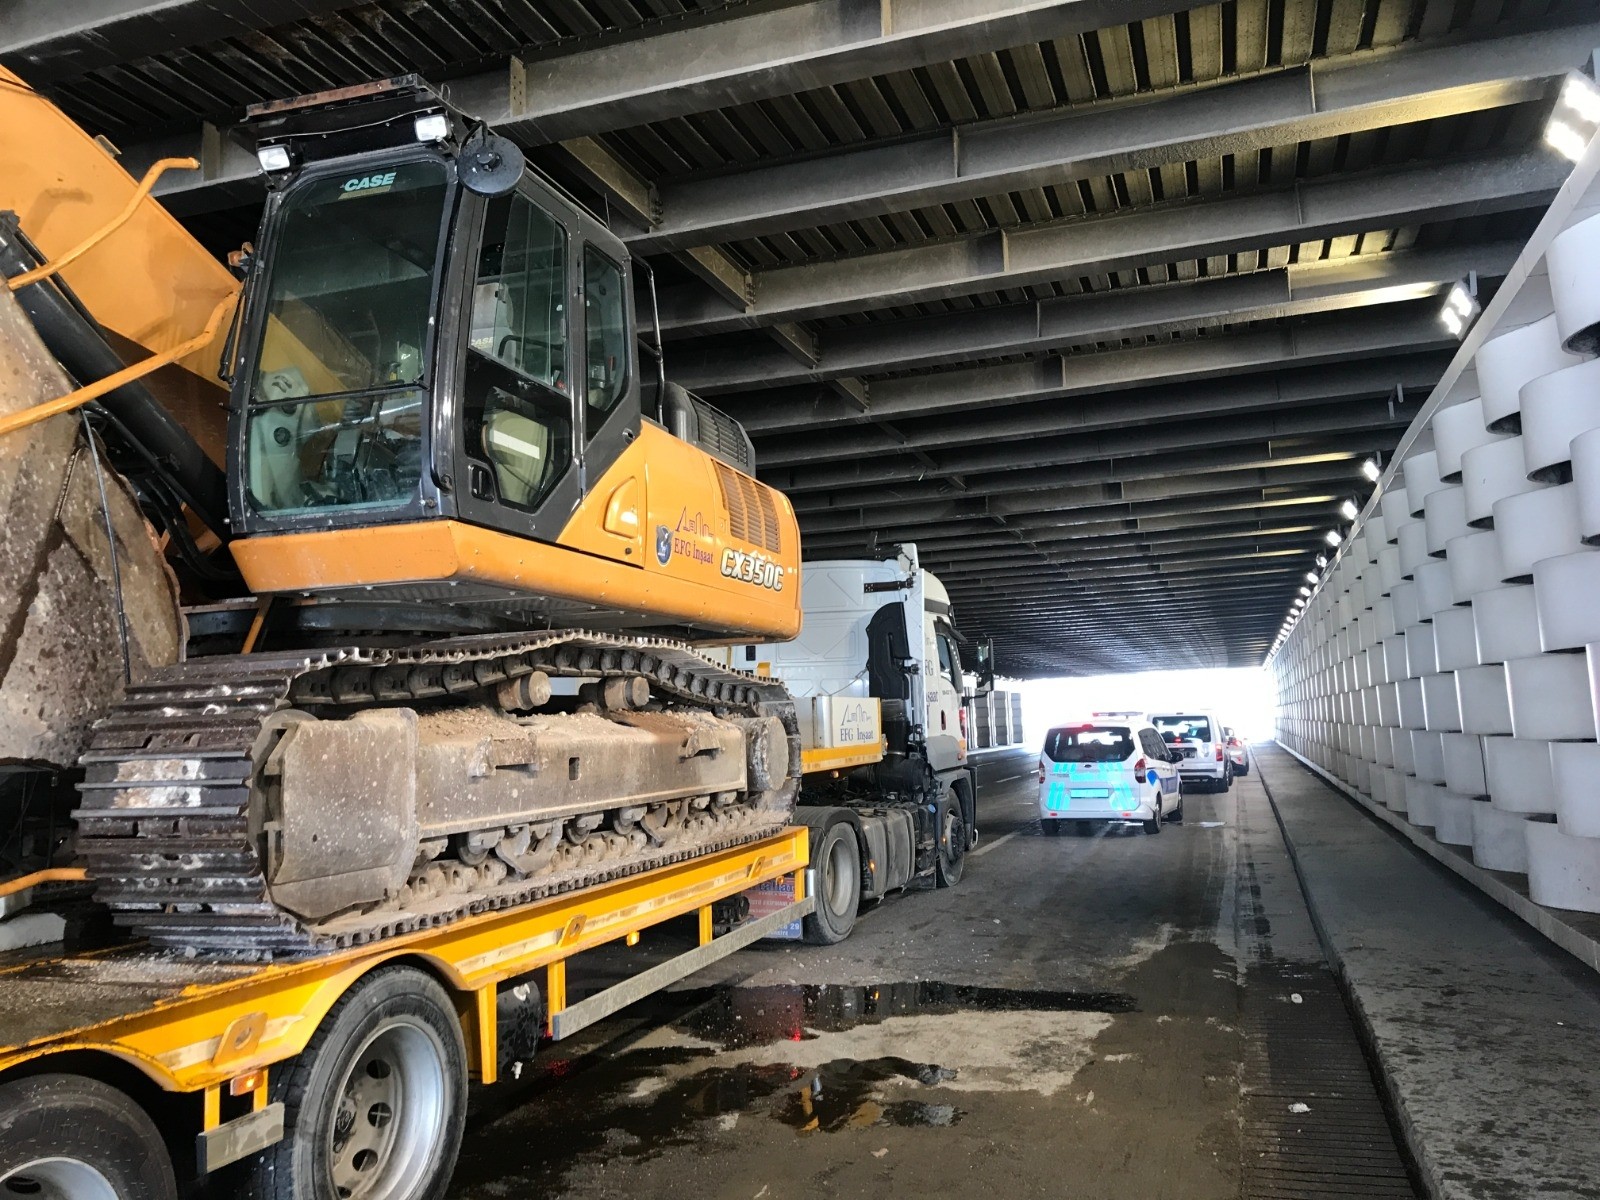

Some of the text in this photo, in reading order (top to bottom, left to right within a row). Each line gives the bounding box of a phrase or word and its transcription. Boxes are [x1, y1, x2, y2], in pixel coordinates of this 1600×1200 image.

[344, 172, 397, 192] CASE
[674, 537, 691, 557] EFG
[720, 547, 784, 591] CX350C
[840, 728, 854, 742] EFG
